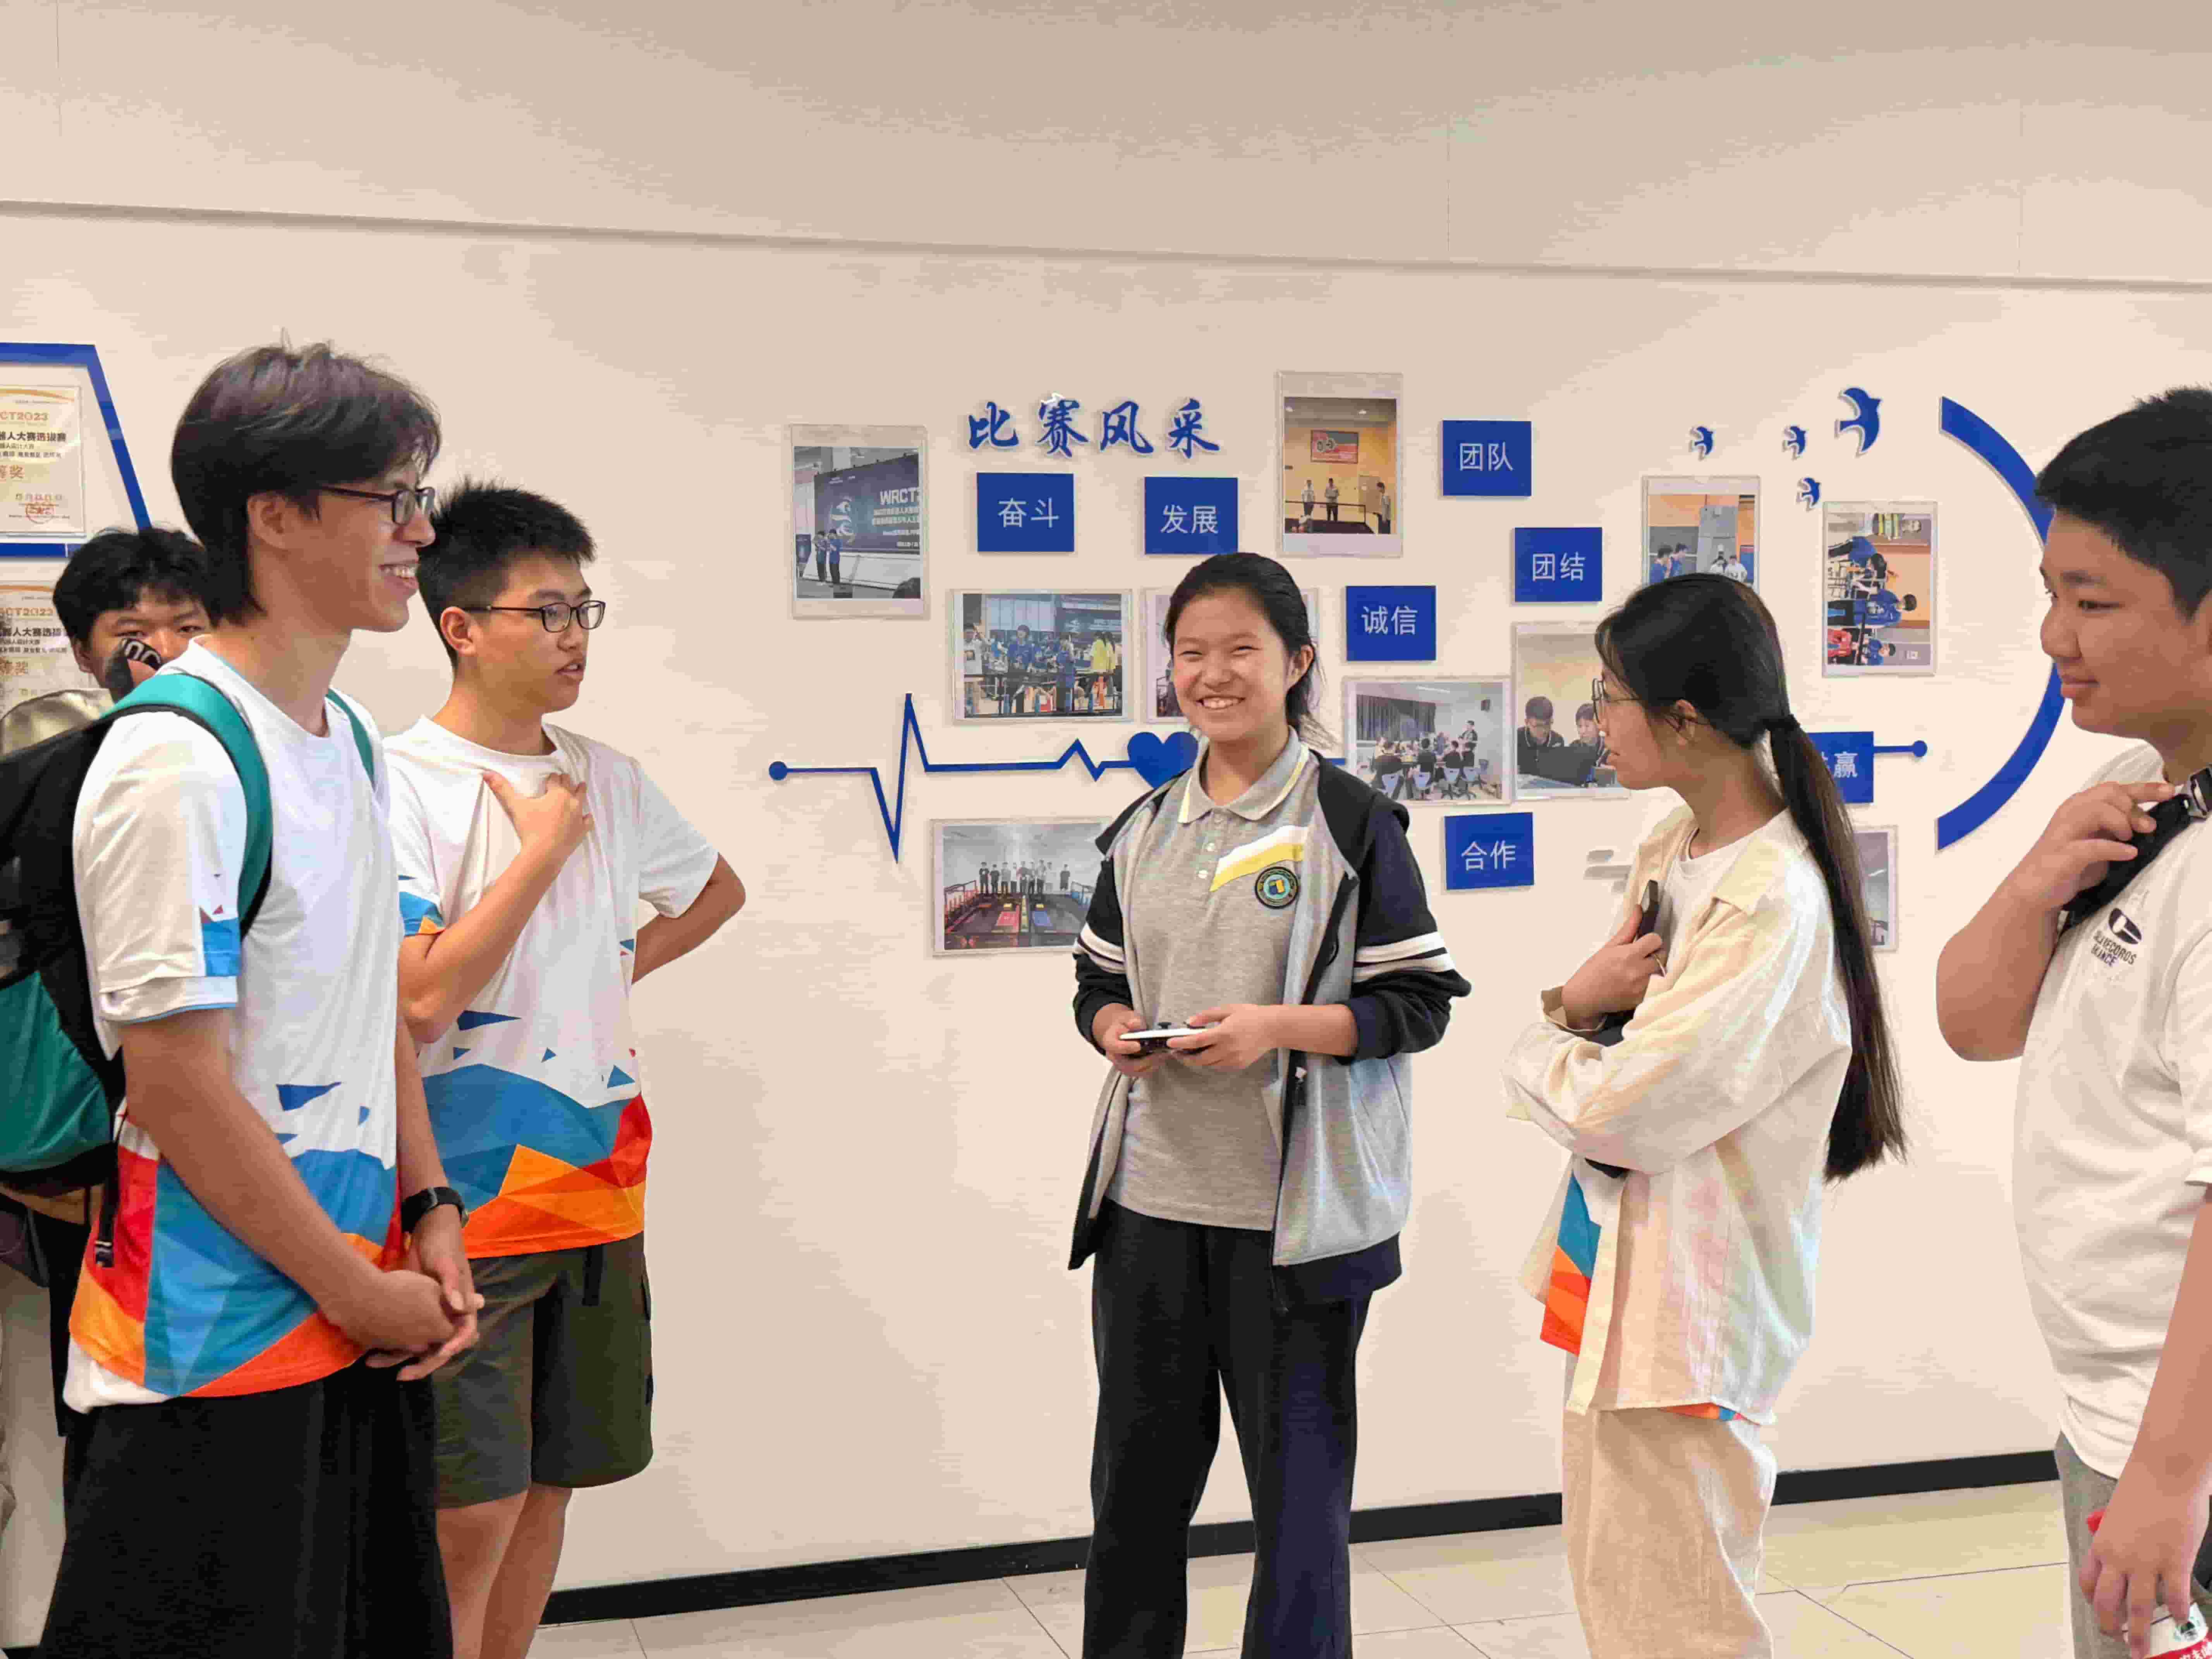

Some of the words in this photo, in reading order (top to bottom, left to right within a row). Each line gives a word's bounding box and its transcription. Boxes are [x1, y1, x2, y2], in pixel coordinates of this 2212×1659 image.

[968, 393, 1220, 459] 比赛风采
[1459, 442, 1513, 471] 团队
[998, 497, 1059, 528] 奋斗
[1160, 504, 1219, 534] 发展
[1532, 552, 1586, 582] 团结
[1361, 605, 1418, 636] 诚信
[1821, 751, 1858, 778] 赢
[1461, 840, 1516, 871] 合作
